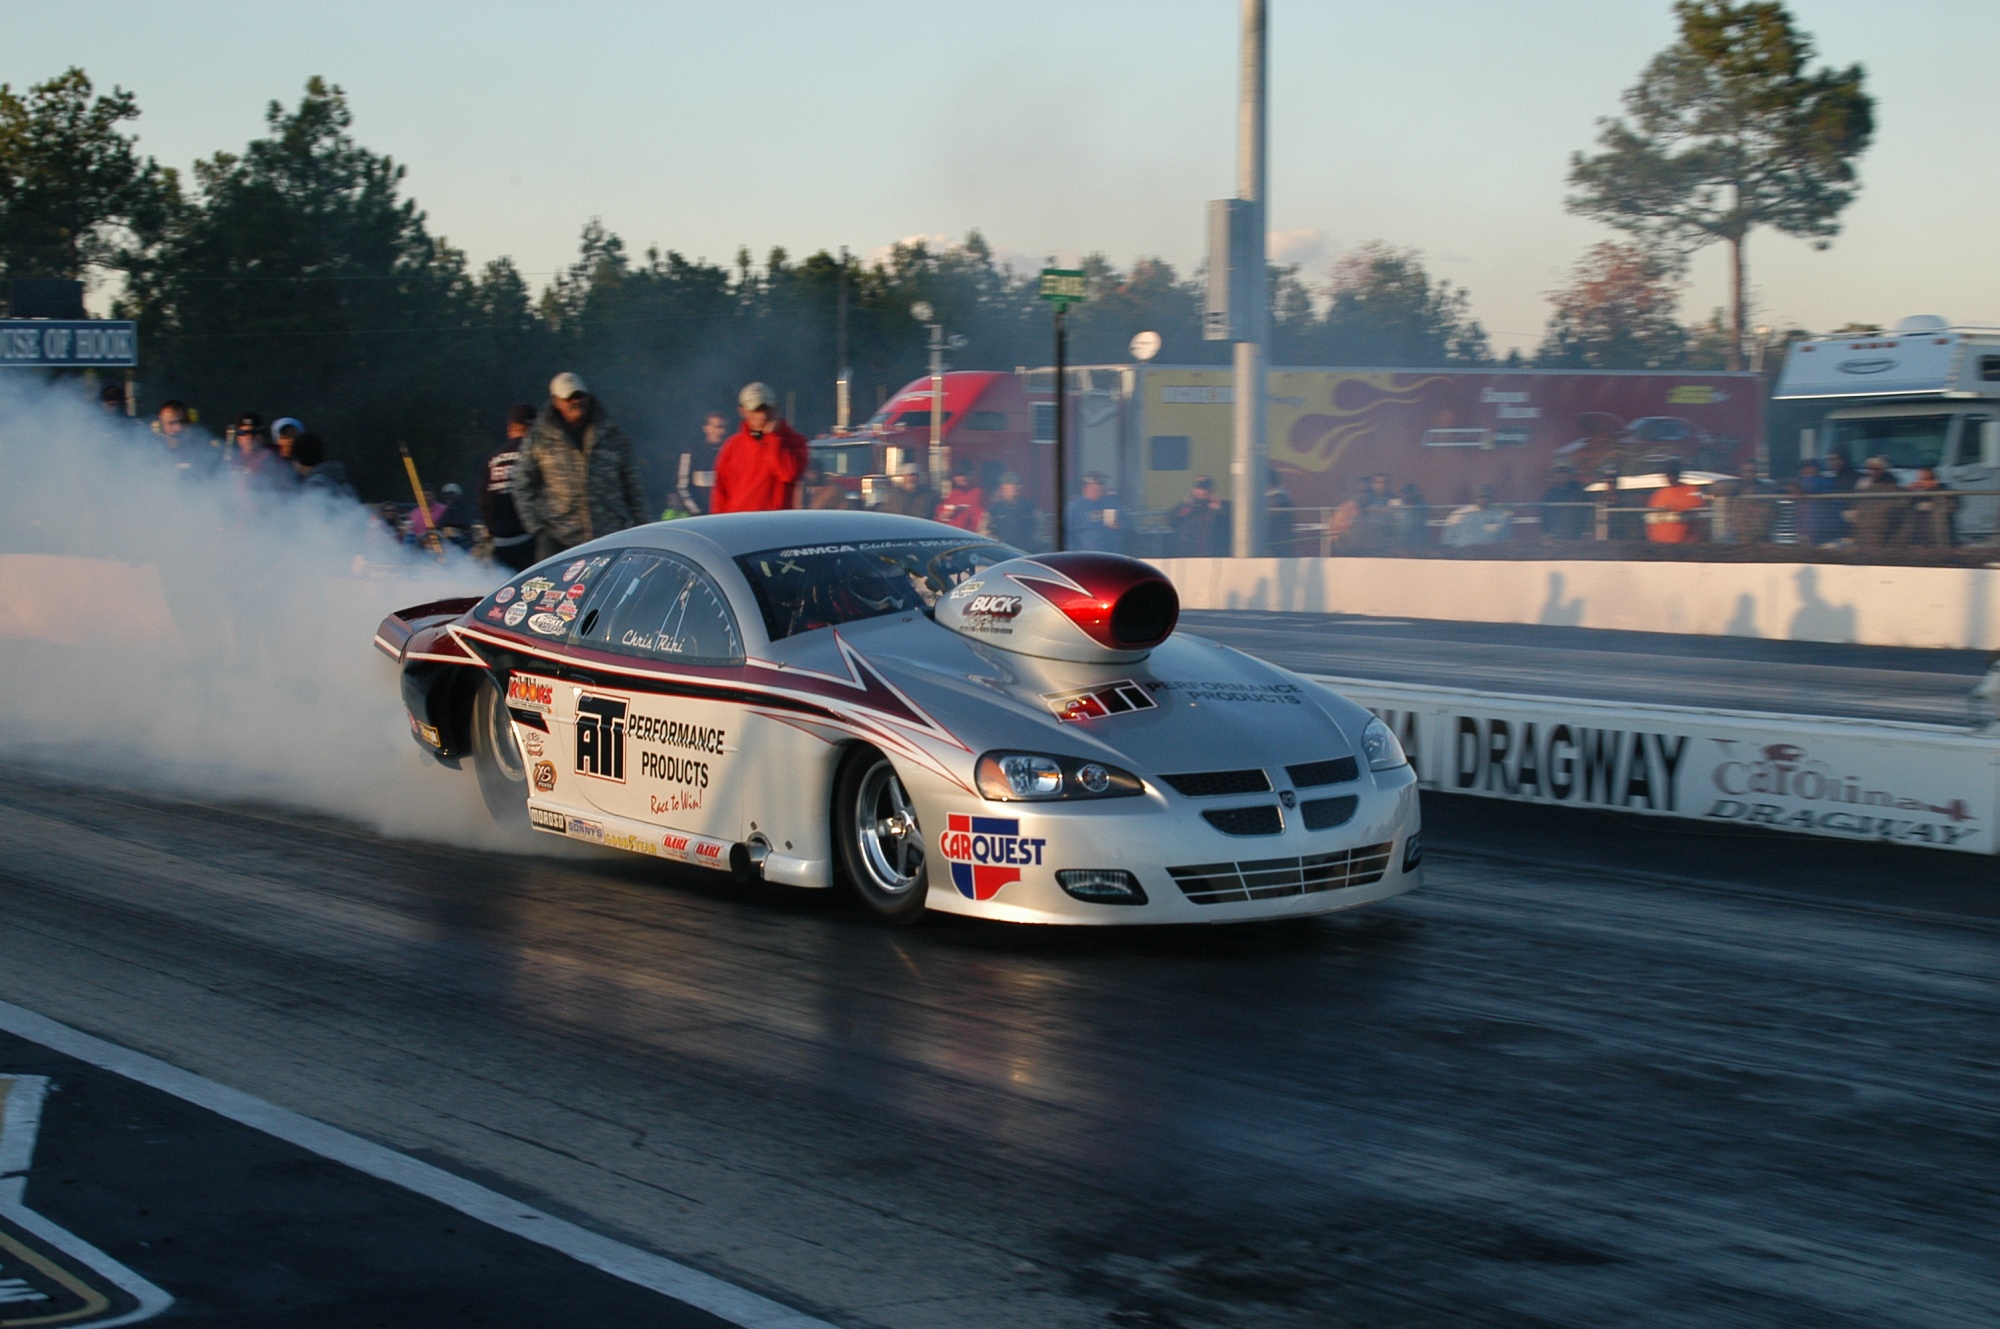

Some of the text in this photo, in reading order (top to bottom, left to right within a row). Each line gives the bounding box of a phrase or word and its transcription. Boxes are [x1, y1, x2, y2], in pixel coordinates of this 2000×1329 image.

[43, 329, 71, 359] OF
[75, 329, 133, 358] HOOK
[793, 545, 856, 557] NMCA
[969, 596, 1020, 612] BUCK
[622, 629, 652, 648] Chris
[509, 681, 553, 705] KOOKS
[1146, 681, 1302, 694] PERFORMANCE
[1187, 691, 1301, 705] PRODUCTS
[575, 691, 725, 784] ATI PERFORMANCE
[642, 751, 709, 789] PRODUCTS
[1455, 715, 1690, 811] DRAGWAY
[651, 788, 702, 814] Race to Win!
[531, 808, 564, 829] MOROSO
[568, 821, 603, 838] SONNY'S
[1703, 800, 1982, 845] DRAGWAY
[940, 831, 1046, 866] CARQUEST
